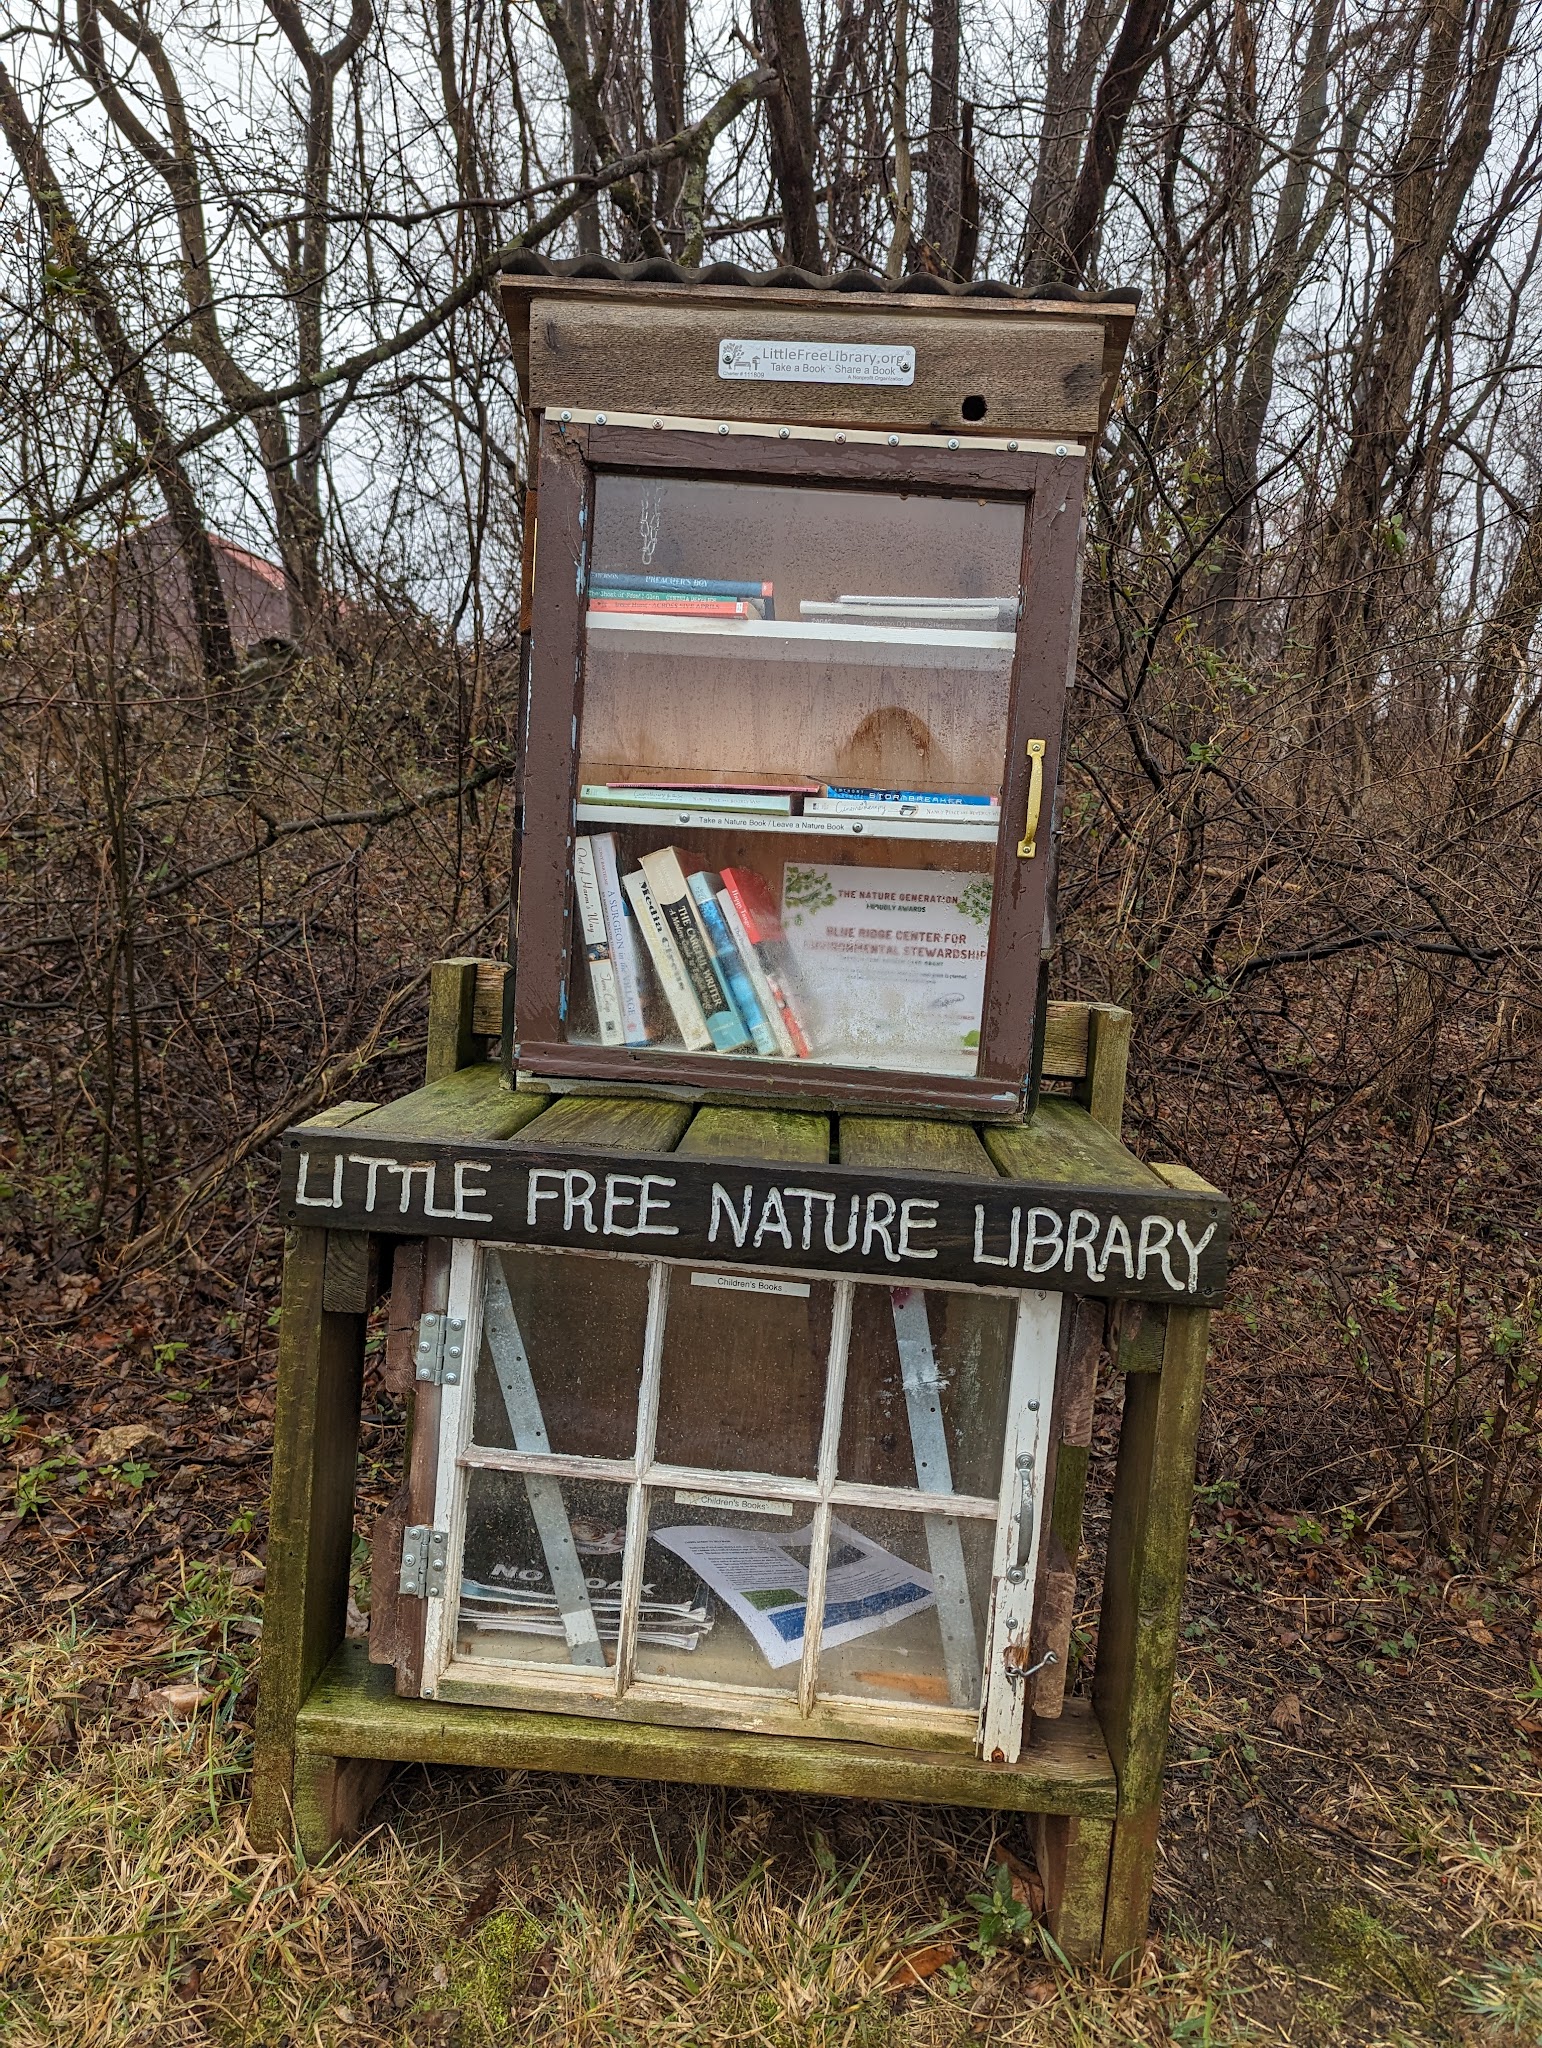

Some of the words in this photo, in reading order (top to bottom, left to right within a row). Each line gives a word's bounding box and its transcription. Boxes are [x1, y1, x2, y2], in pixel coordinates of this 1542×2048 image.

[762, 348, 905, 367] LittleFreeLibrary.org
[771, 362, 792, 372] Take
[802, 363, 825, 373] Book
[835, 365, 861, 374] Share
[872, 366, 896, 375] Book
[868, 792, 963, 805] STORMBREAKER
[699, 816, 716, 824] Take
[724, 818, 747, 826] Nature
[749, 819, 766, 827] Book
[772, 820, 794, 828] Leave
[801, 822, 825, 830] Nature
[826, 823, 845, 831] Book
[731, 888, 743, 910] Happy
[838, 889, 856, 899] THE
[858, 891, 896, 901] NATURE
[898, 893, 959, 905] GENERATION
[638, 881, 663, 933] Media
[897, 904, 927, 913] AWARDS
[587, 912, 600, 934] Way
[609, 899, 625, 950] SURGEON
[825, 926, 856, 938] BLUE
[858, 927, 893, 940] RIDGE
[895, 930, 941, 943] CENTER
[943, 933, 967, 945] FOR
[678, 905, 692, 927] THE
[702, 968, 722, 1007] WRITER
[902, 946, 987, 961] STEWARDSHIP
[295, 1152, 494, 1223] LITTLE
[526, 1167, 680, 1238] FREE
[707, 1181, 940, 1263] NATURE
[973, 1203, 1218, 1294] LIBRARY
[717, 1277, 756, 1289] Children's
[758, 1281, 783, 1292] Books
[700, 1495, 740, 1508] Children's
[741, 1500, 767, 1511] Books
[490, 1563, 545, 1582] NO
